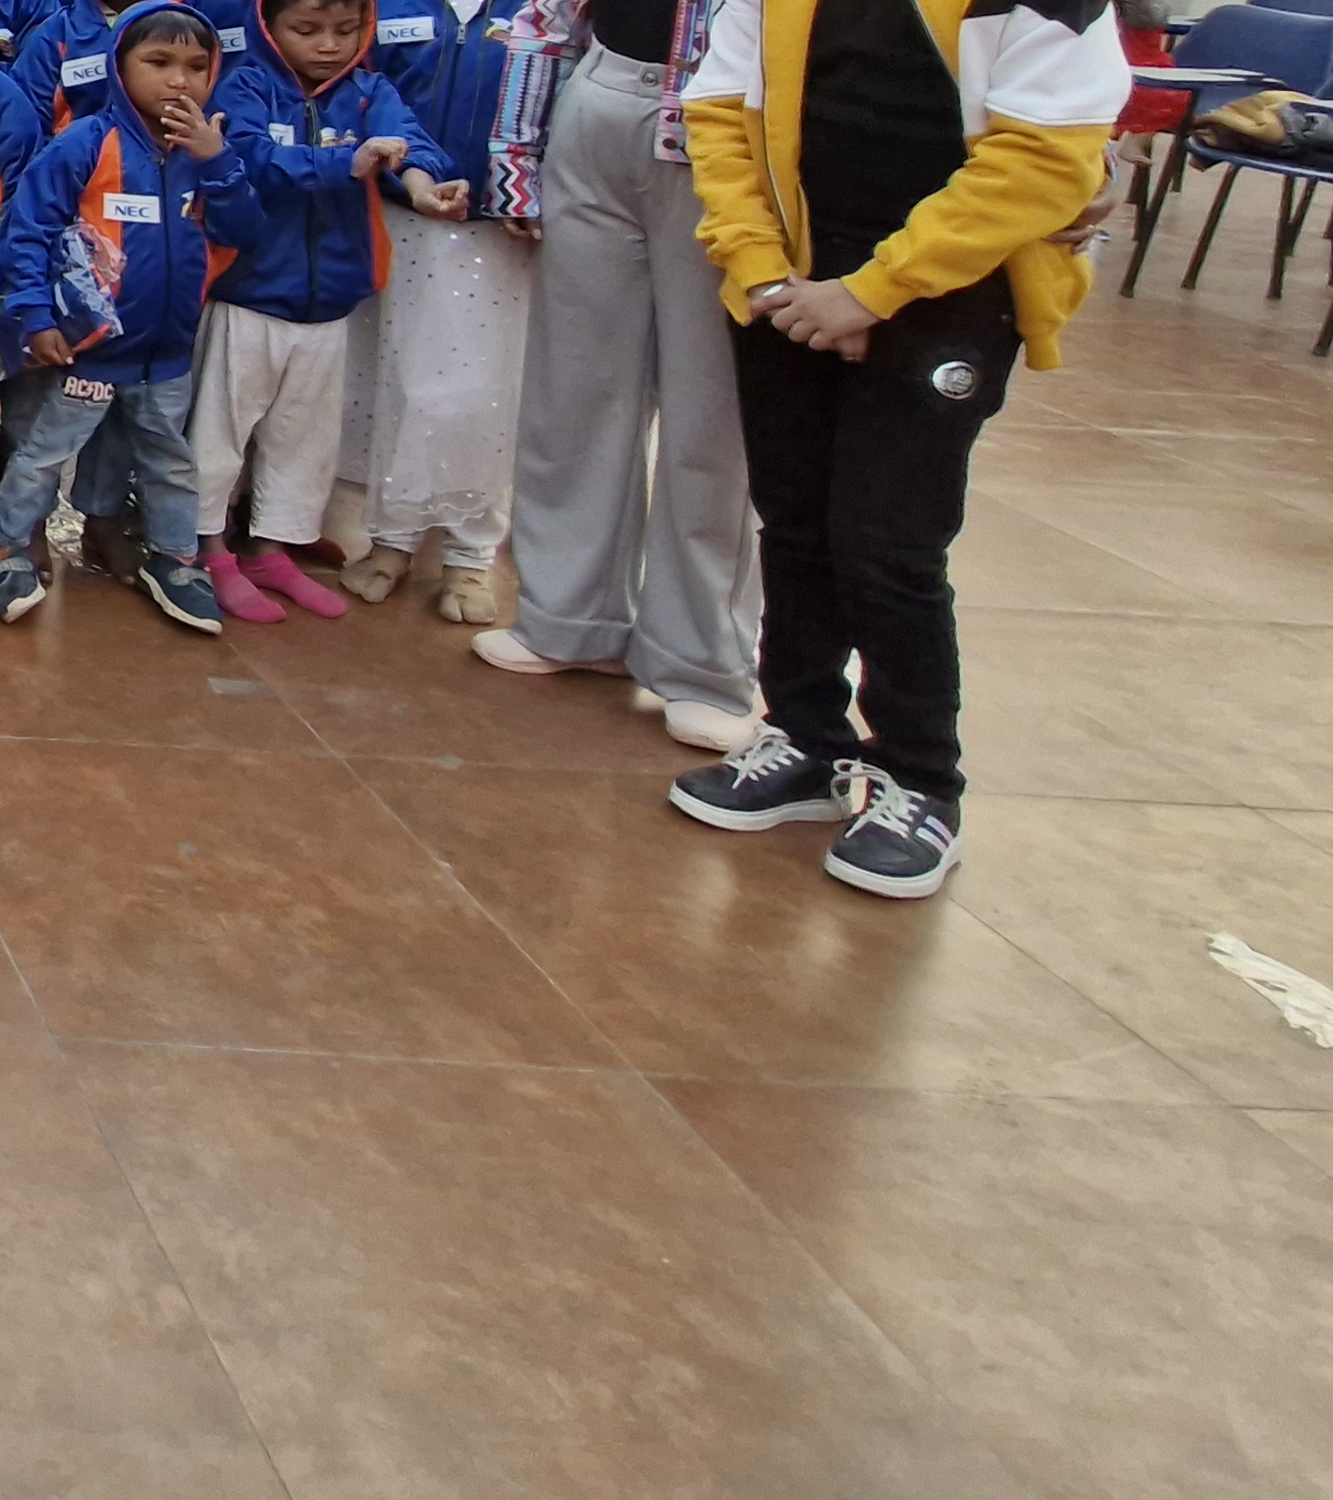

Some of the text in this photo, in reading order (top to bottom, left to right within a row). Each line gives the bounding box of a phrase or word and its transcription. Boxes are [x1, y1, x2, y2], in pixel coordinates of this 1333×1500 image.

[388, 27, 422, 39] NEC
[73, 64, 105, 80] NEC
[115, 205, 151, 218] NEC
